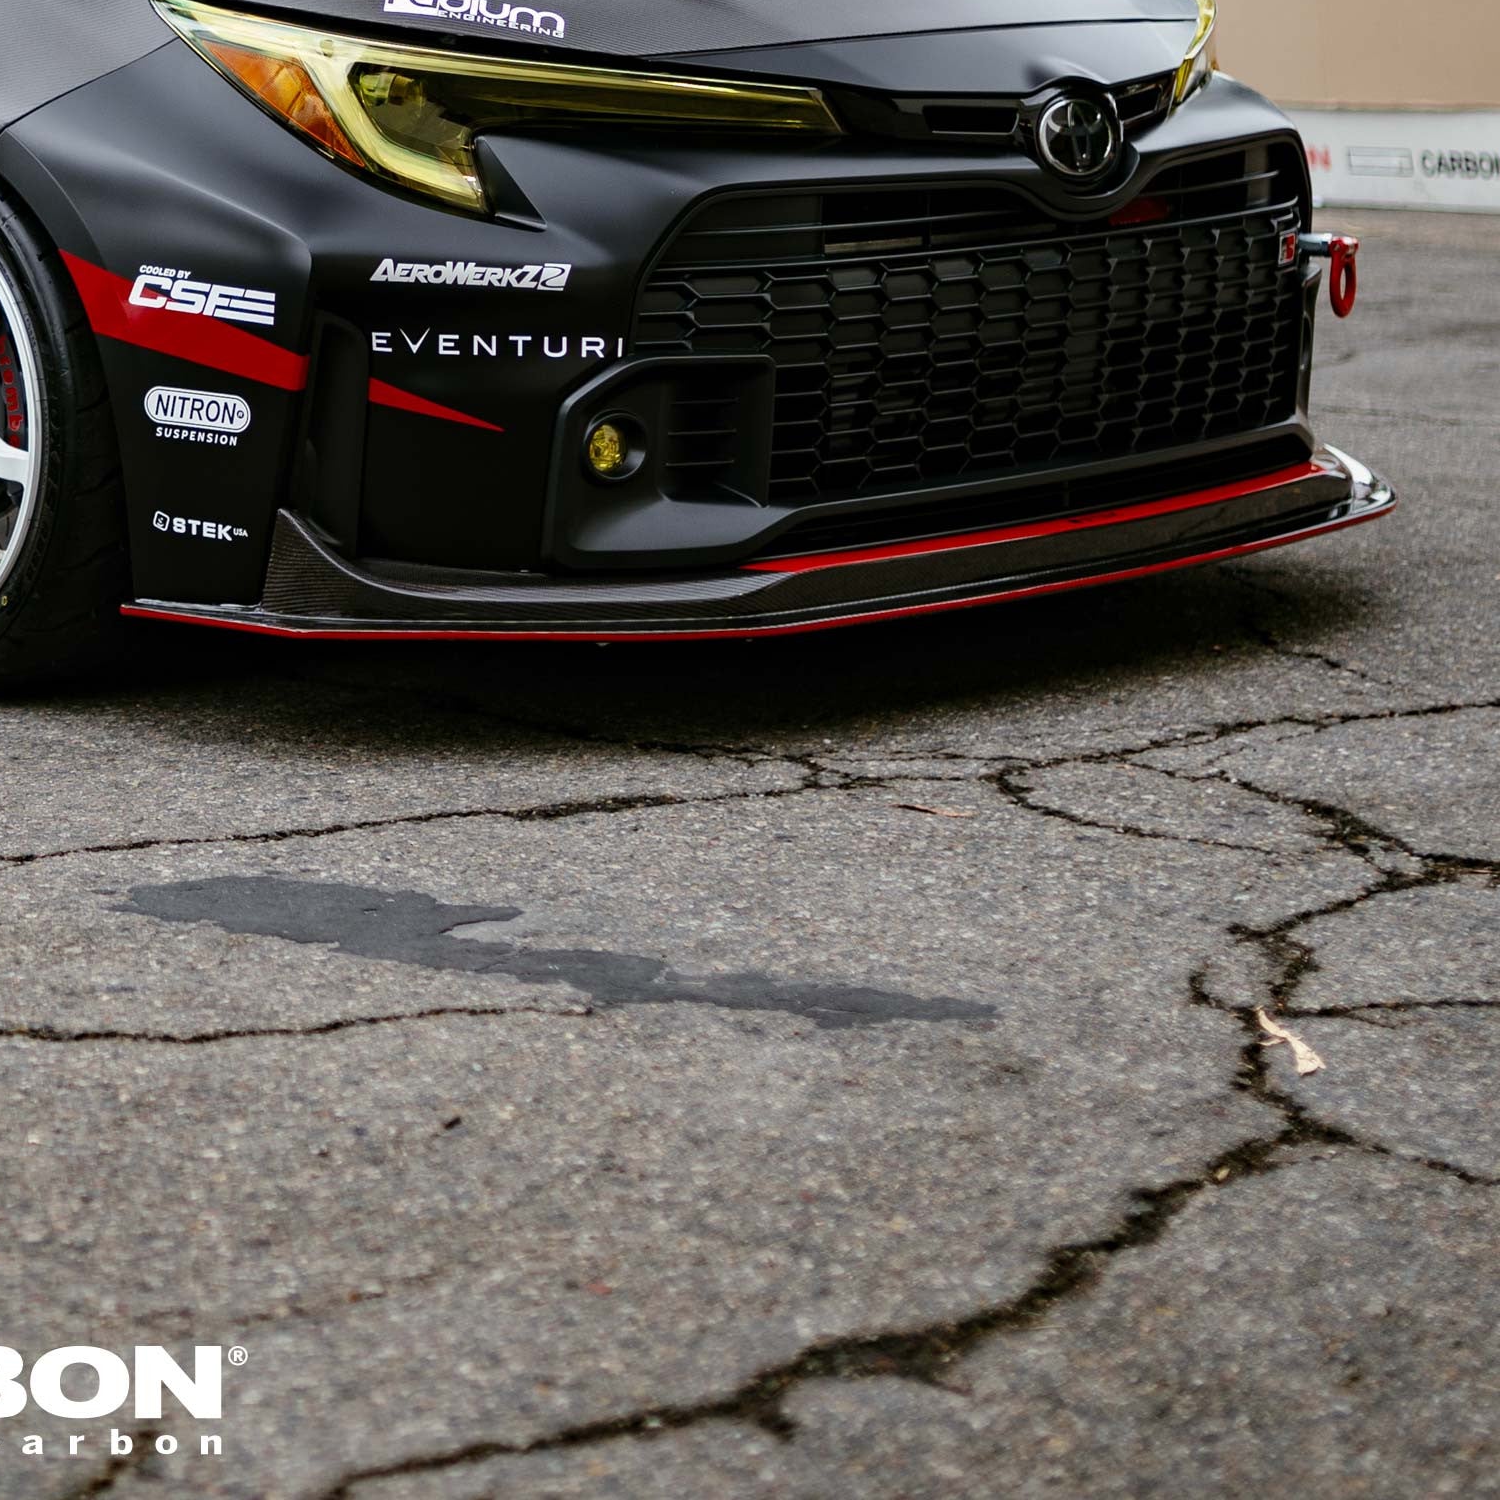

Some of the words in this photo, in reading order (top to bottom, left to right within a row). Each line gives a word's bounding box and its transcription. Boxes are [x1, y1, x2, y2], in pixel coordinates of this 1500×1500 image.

[437, 10, 565, 39] ENGINEERING
[139, 265, 177, 278] COOLED
[177, 270, 192, 280] BY
[128, 274, 276, 326] CSF
[371, 327, 624, 358] EVENTURI
[155, 426, 238, 447] SUSPENSION
[172, 516, 233, 542] STEK
[233, 528, 249, 538] USA
